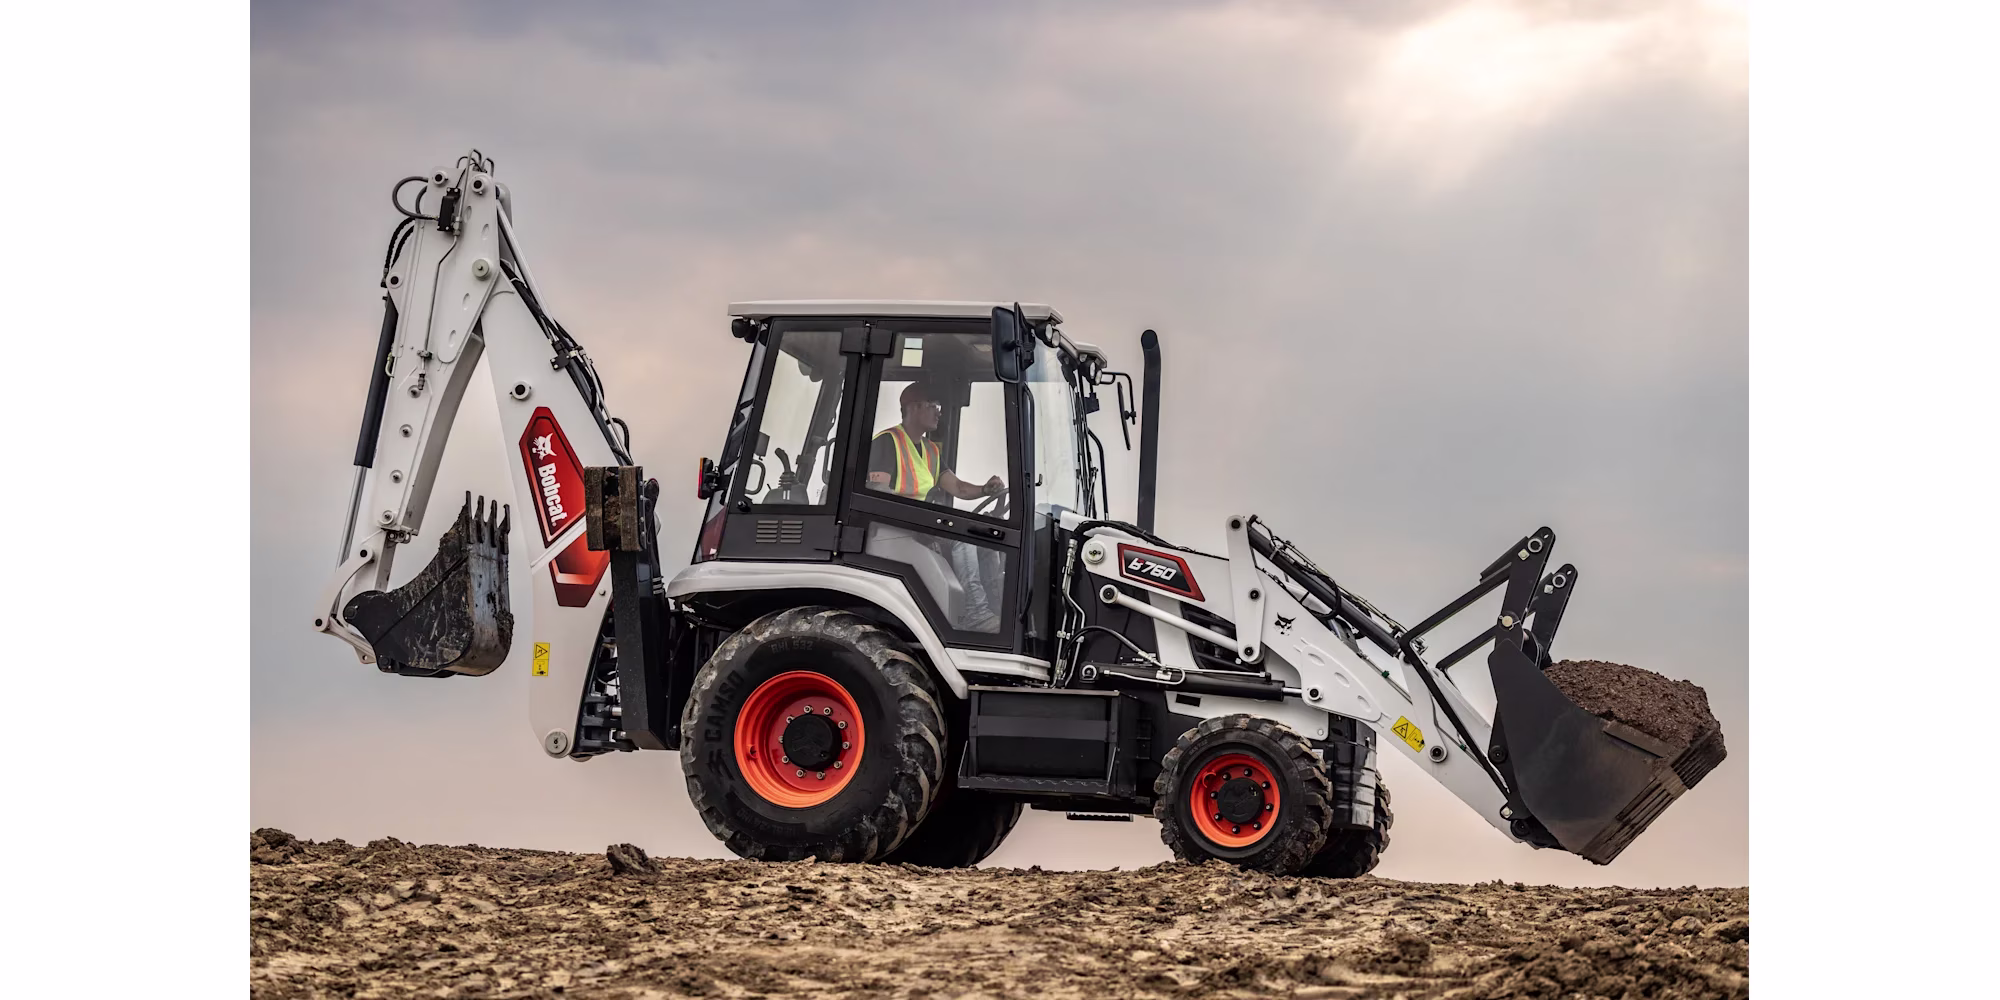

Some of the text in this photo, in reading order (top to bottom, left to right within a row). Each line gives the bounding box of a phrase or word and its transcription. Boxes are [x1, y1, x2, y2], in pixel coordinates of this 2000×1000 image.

[1128, 557, 1177, 581] B760
[792, 640, 813, 650] 532
[704, 670, 744, 741] CAMSO
